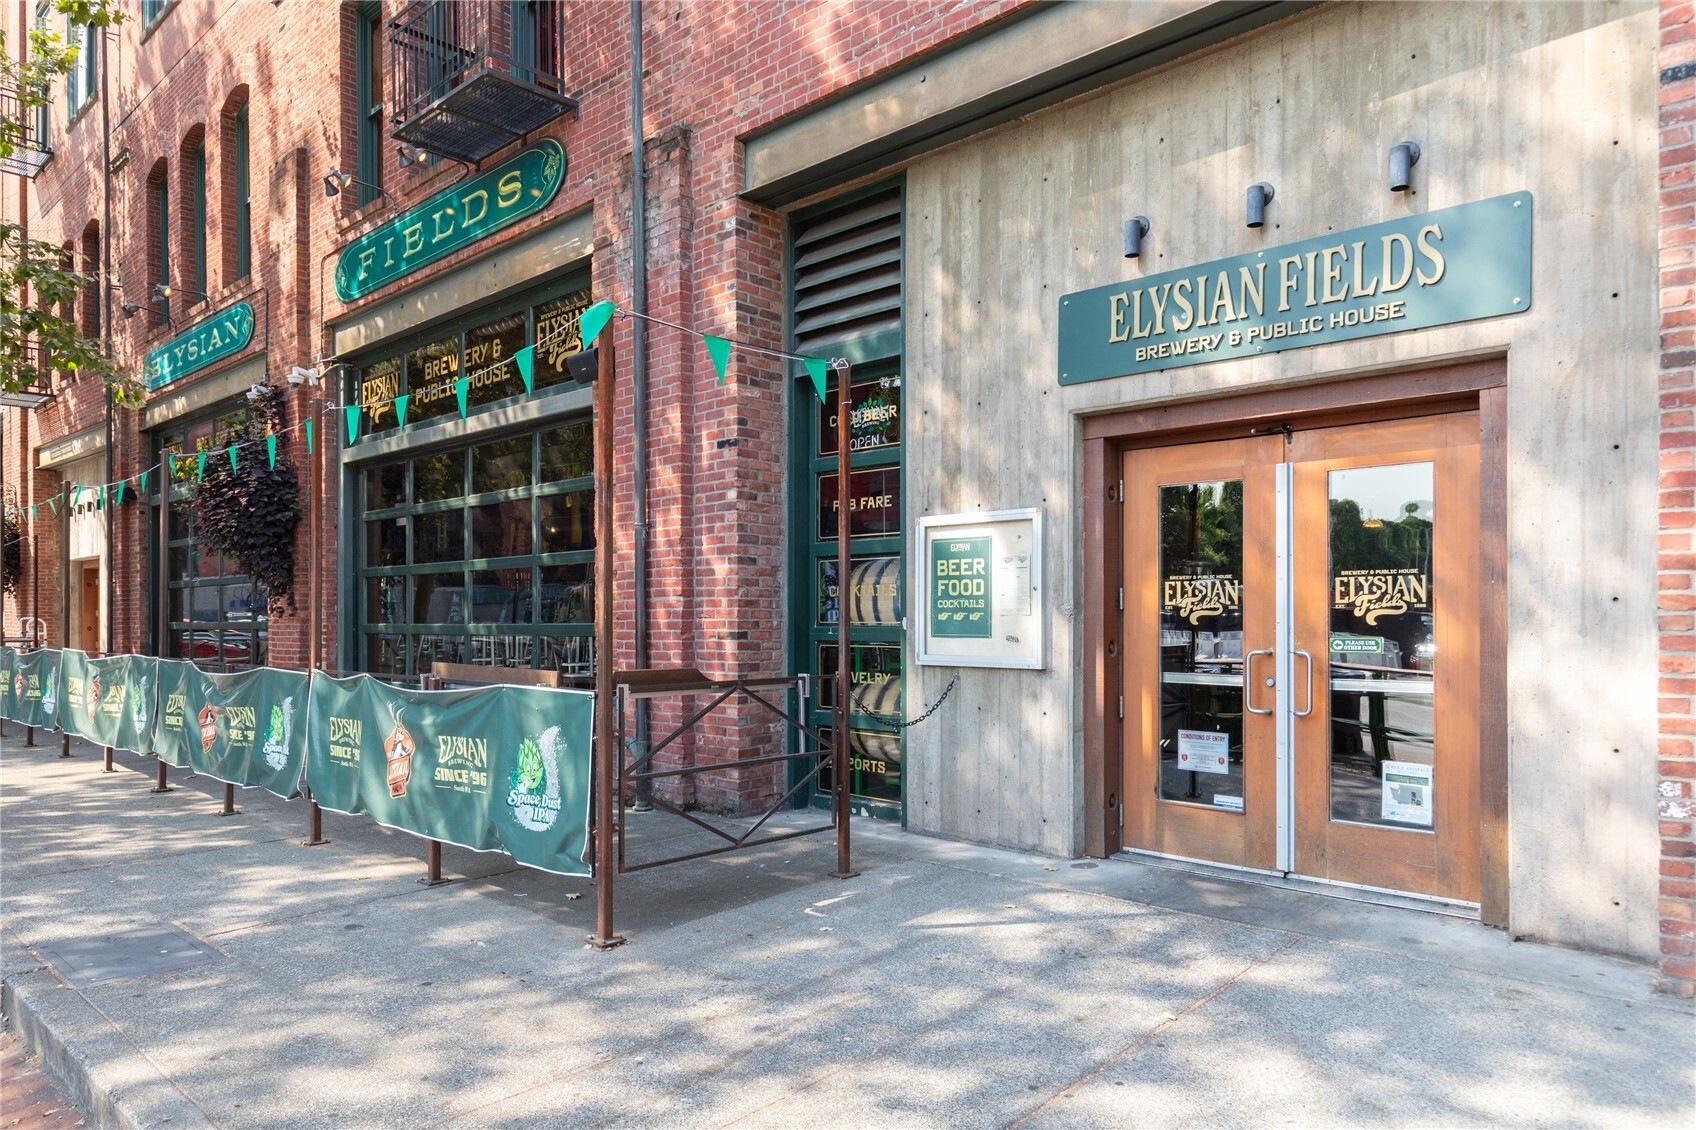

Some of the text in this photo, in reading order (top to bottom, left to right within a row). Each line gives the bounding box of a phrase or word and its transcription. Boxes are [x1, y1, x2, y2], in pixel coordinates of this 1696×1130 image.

[359, 170, 523, 281] FIELDS
[1108, 223, 1447, 345] ELYSIAN FIELDS
[537, 308, 587, 353] ELYSIA
[1135, 301, 1405, 362] BREWERY & PUBLIC HOUSE
[149, 316, 240, 379] ELYSIAN
[424, 339, 502, 380] BREWERY &
[362, 372, 399, 407] ELYSIAN
[415, 364, 511, 405] PUBLIC HOUSE
[829, 411, 860, 428] CD
[863, 405, 897, 422] BEER
[850, 434, 879, 451] OPEN
[833, 495, 893, 512] PB FARE
[937, 558, 986, 576] BEER
[828, 584, 897, 597] CKTAILS
[937, 579, 985, 597] FOOD
[1164, 579, 1239, 606] ELYSIAN
[1335, 575, 1427, 604] ELYSIAN
[937, 599, 985, 608] COCKTAILS
[1180, 593, 1223, 626] Fields
[1353, 590, 1408, 626] Fields
[329, 716, 363, 746] ELYSIAN
[1180, 733, 1206, 741] CONDITIONS
[329, 744, 352, 759] SINCE
[438, 735, 487, 768] ELYSIAN
[447, 758, 474, 769] BREWING
[434, 767, 487, 787] SINCE '96
[849, 758, 886, 774] ORTS
[507, 789, 562, 811] Space Dust
[532, 807, 550, 824] IPA
